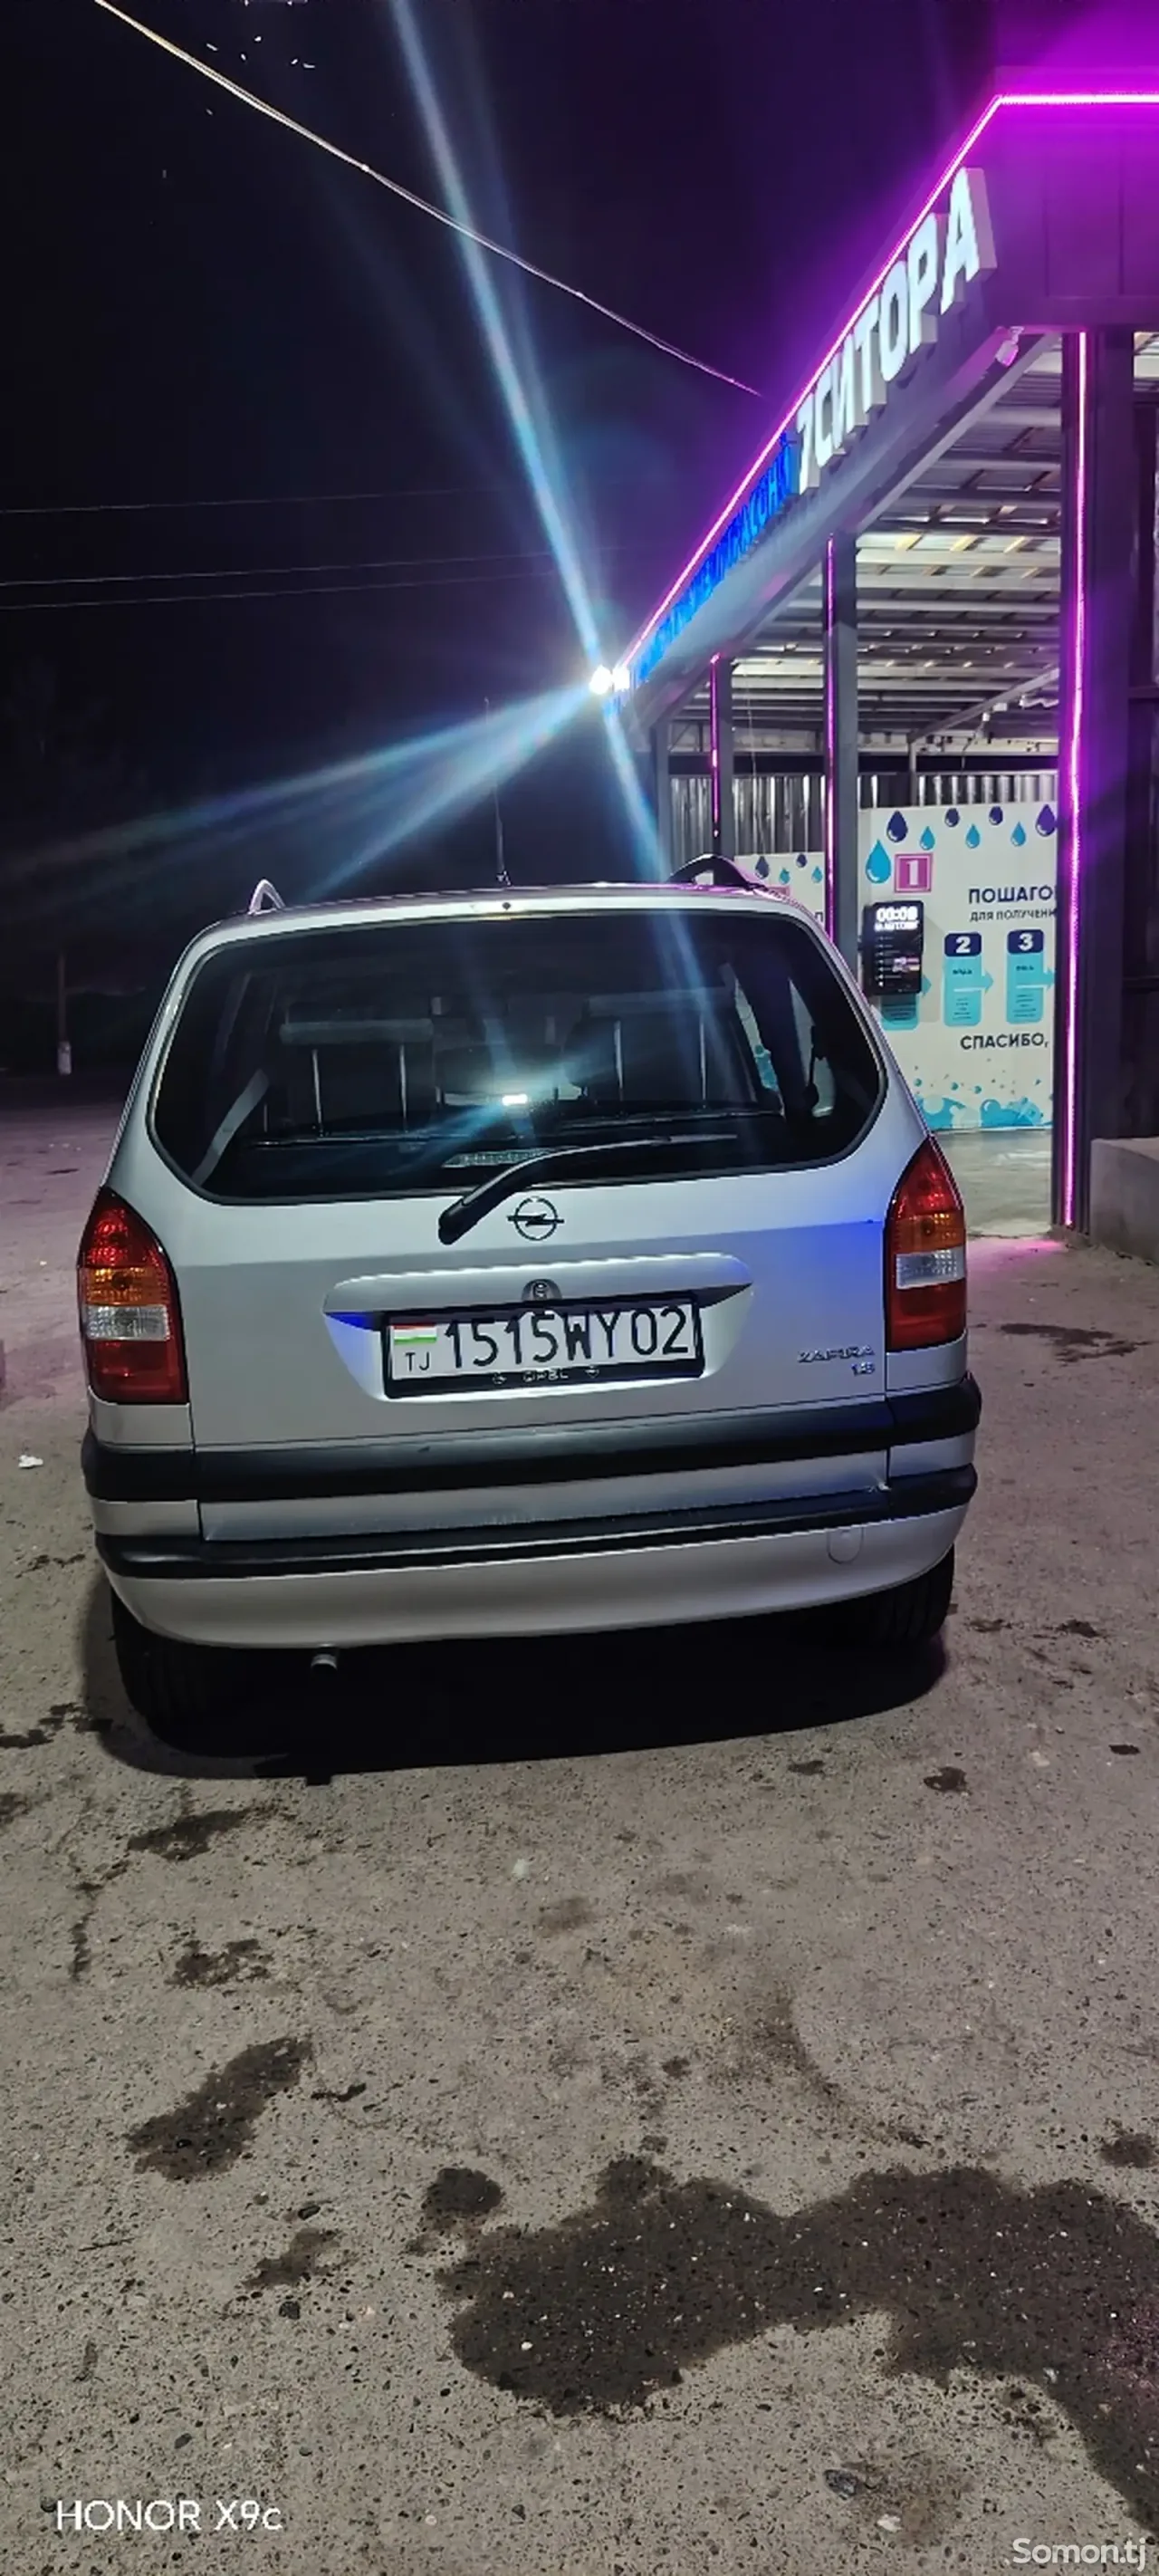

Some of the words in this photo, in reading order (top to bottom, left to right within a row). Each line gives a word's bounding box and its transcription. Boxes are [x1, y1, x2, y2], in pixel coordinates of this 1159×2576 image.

[969, 885, 1057, 904] ПОШАГО
[955, 936, 972, 954] 2
[1018, 933, 1034, 951] 3
[444, 1304, 689, 1370] 1515WY02
[405, 1352, 431, 1372] TJ
